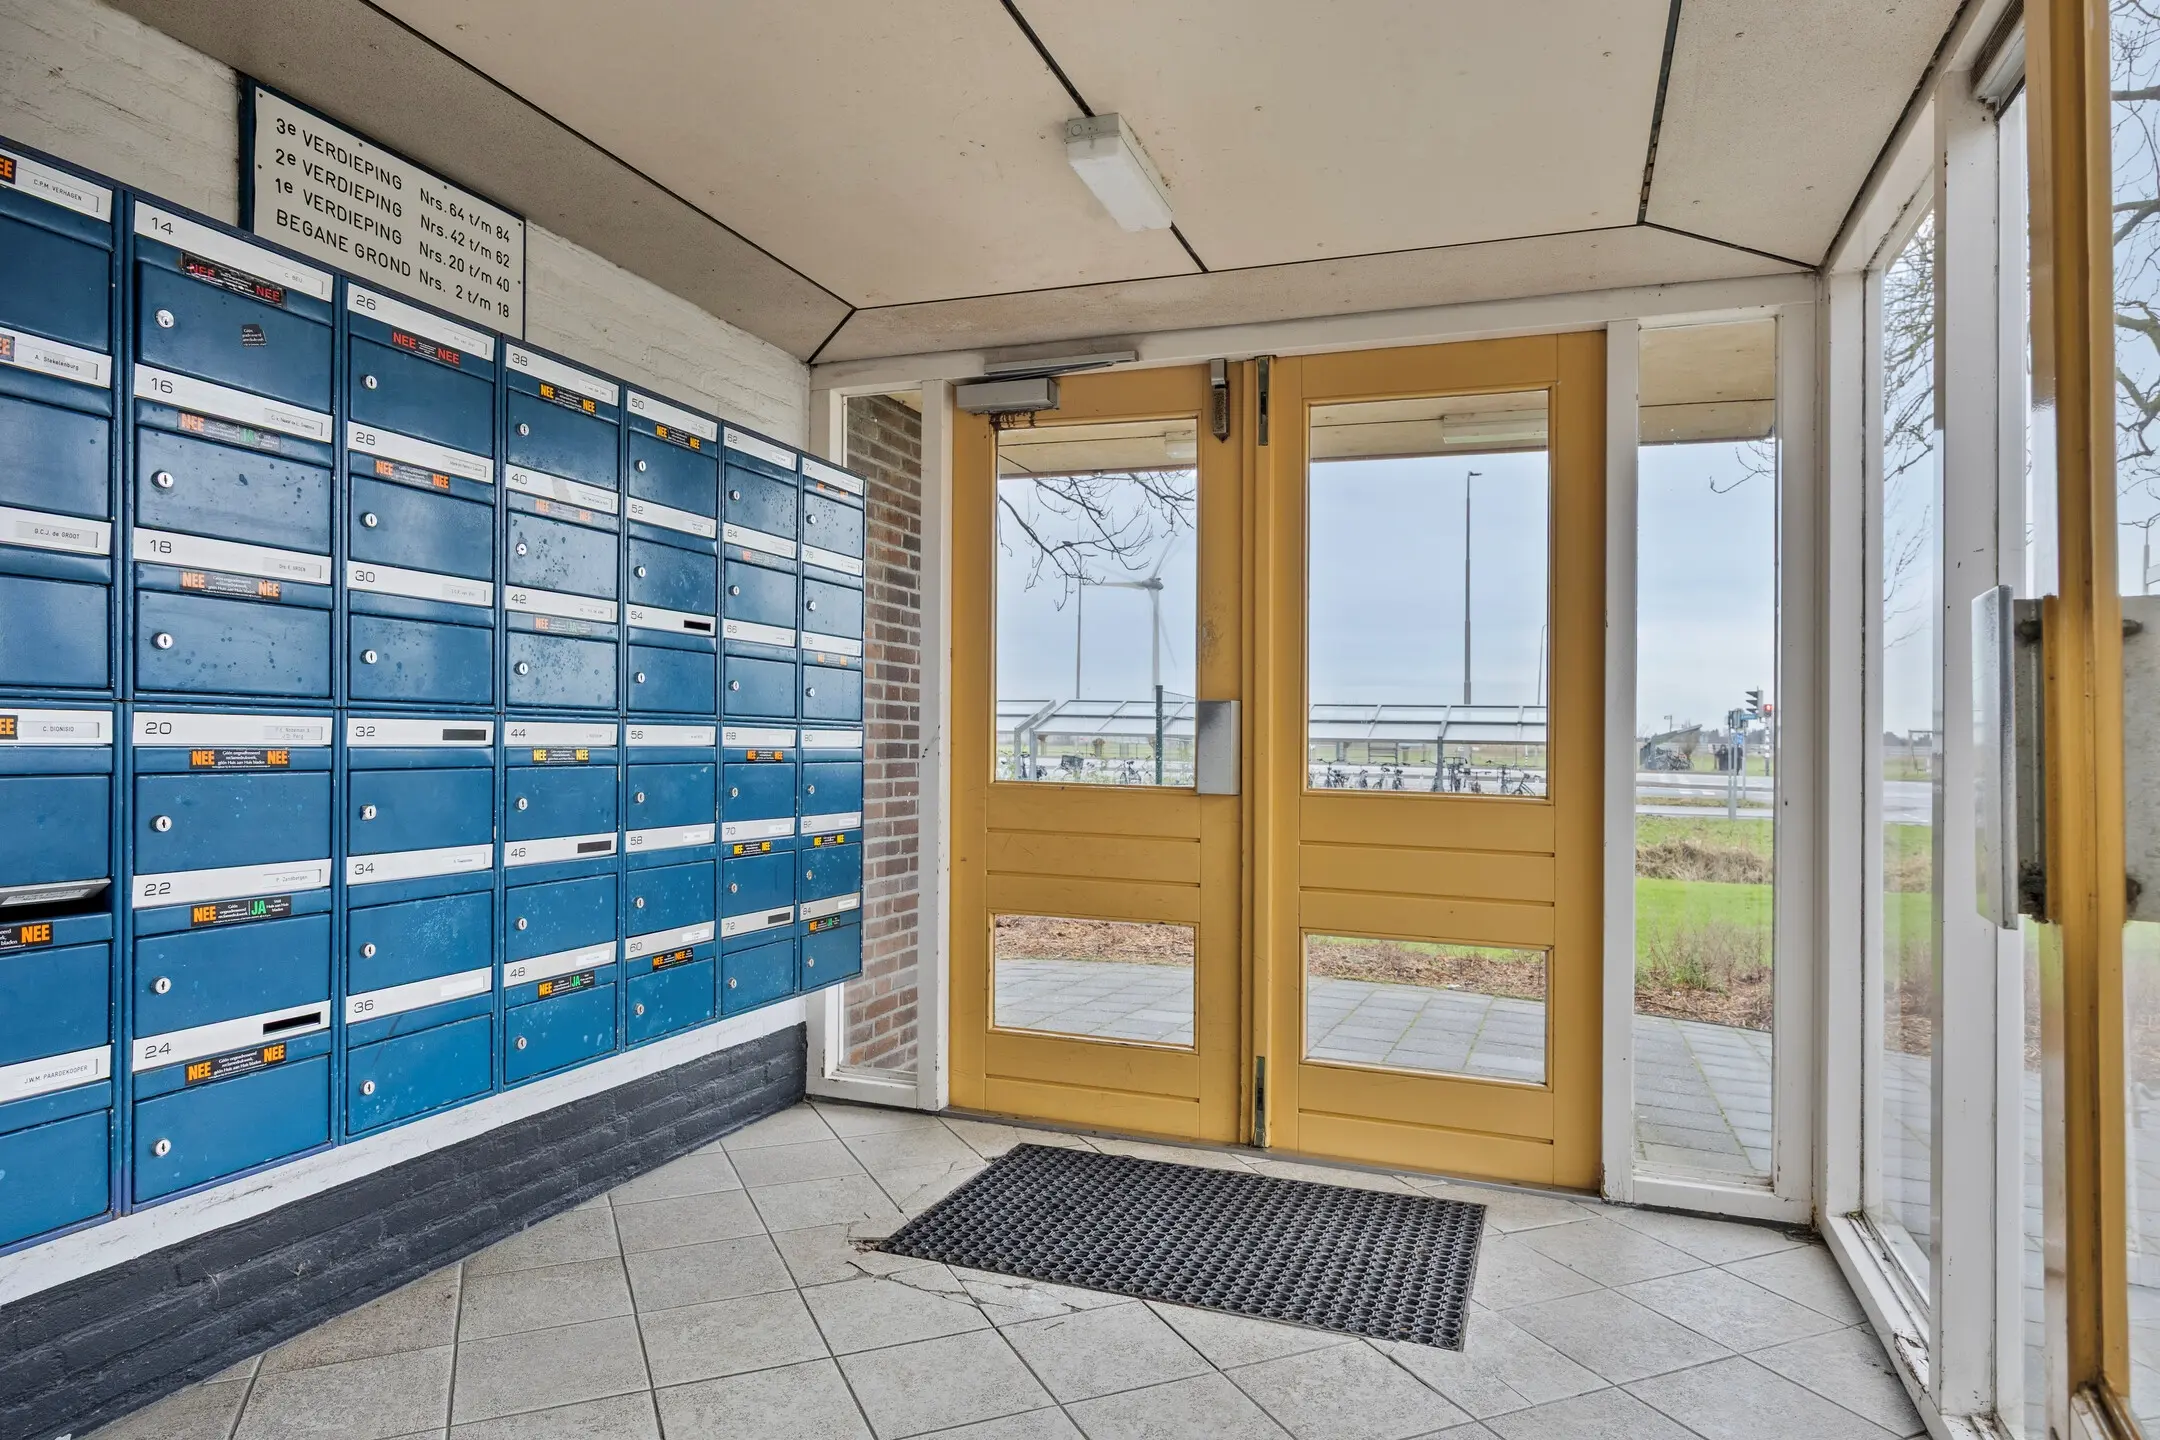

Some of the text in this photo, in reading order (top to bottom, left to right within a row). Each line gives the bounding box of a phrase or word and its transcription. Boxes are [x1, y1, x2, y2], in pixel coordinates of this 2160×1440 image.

[276, 118, 296, 136] 3e
[303, 130, 402, 190] VERDIEPING
[469, 214, 491, 235] t/m
[496, 227, 510, 242] 84
[52, 186, 82, 201] VERHAGEN
[276, 150, 296, 165] 2e
[303, 160, 402, 217] VERDIEPING
[469, 238, 491, 260] t/m
[496, 251, 510, 268] 62
[152, 217, 173, 235] 14
[276, 178, 293, 194] 1e
[304, 189, 402, 245] VERDIEPING
[469, 263, 491, 284] t/m
[496, 276, 510, 292] 40
[277, 210, 509, 317] BEGANE GROND Nrs. 2 t/m 18
[190, 264, 216, 278] NEE
[256, 286, 280, 302] NEE
[356, 294, 376, 310] 26
[393, 332, 416, 349] NEE
[438, 348, 459, 364] NEE
[512, 353, 528, 366] 38
[43, 356, 79, 371] Stekelenburg
[151, 377, 173, 394] 16
[540, 384, 554, 399] NEE
[583, 400, 595, 412] NEE
[632, 398, 644, 410] 50
[181, 412, 204, 432] NEE
[356, 432, 376, 446] 28
[728, 434, 737, 444] 62
[376, 460, 393, 476] NEE
[433, 474, 449, 489] NEE
[512, 473, 527, 485] 40
[631, 504, 643, 515] 52
[62, 531, 80, 539] GROOT
[150, 539, 172, 554] 18
[182, 572, 205, 588] NEE
[355, 570, 375, 582] 30
[258, 580, 279, 597] NEE
[511, 594, 527, 604] 42
[630, 611, 643, 620] 54
[536, 618, 549, 629] NEE
[145, 722, 172, 734] 20
[356, 726, 376, 737] 32
[511, 728, 526, 738] 44
[631, 730, 643, 740] 56
[192, 750, 215, 765] NEE
[267, 750, 288, 764] NEE
[534, 750, 546, 760] NEE
[576, 750, 588, 760] NEE
[726, 826, 736, 836] 70
[630, 836, 642, 845] 58
[511, 848, 526, 858] 46
[354, 862, 374, 875] 34
[144, 882, 170, 896] 22
[194, 906, 216, 922] NEE
[251, 900, 266, 915] JA
[803, 907, 811, 915] 84
[22, 924, 50, 944] NEE
[630, 942, 642, 952] 60
[510, 967, 525, 978] 48
[572, 975, 580, 987] JA
[539, 982, 552, 996] NEE
[354, 1000, 374, 1014] 36
[145, 1042, 171, 1058] 24
[264, 1045, 284, 1062] NEE
[43, 1064, 88, 1080] PAARDEKOOPER
[188, 1062, 211, 1080] NEE
